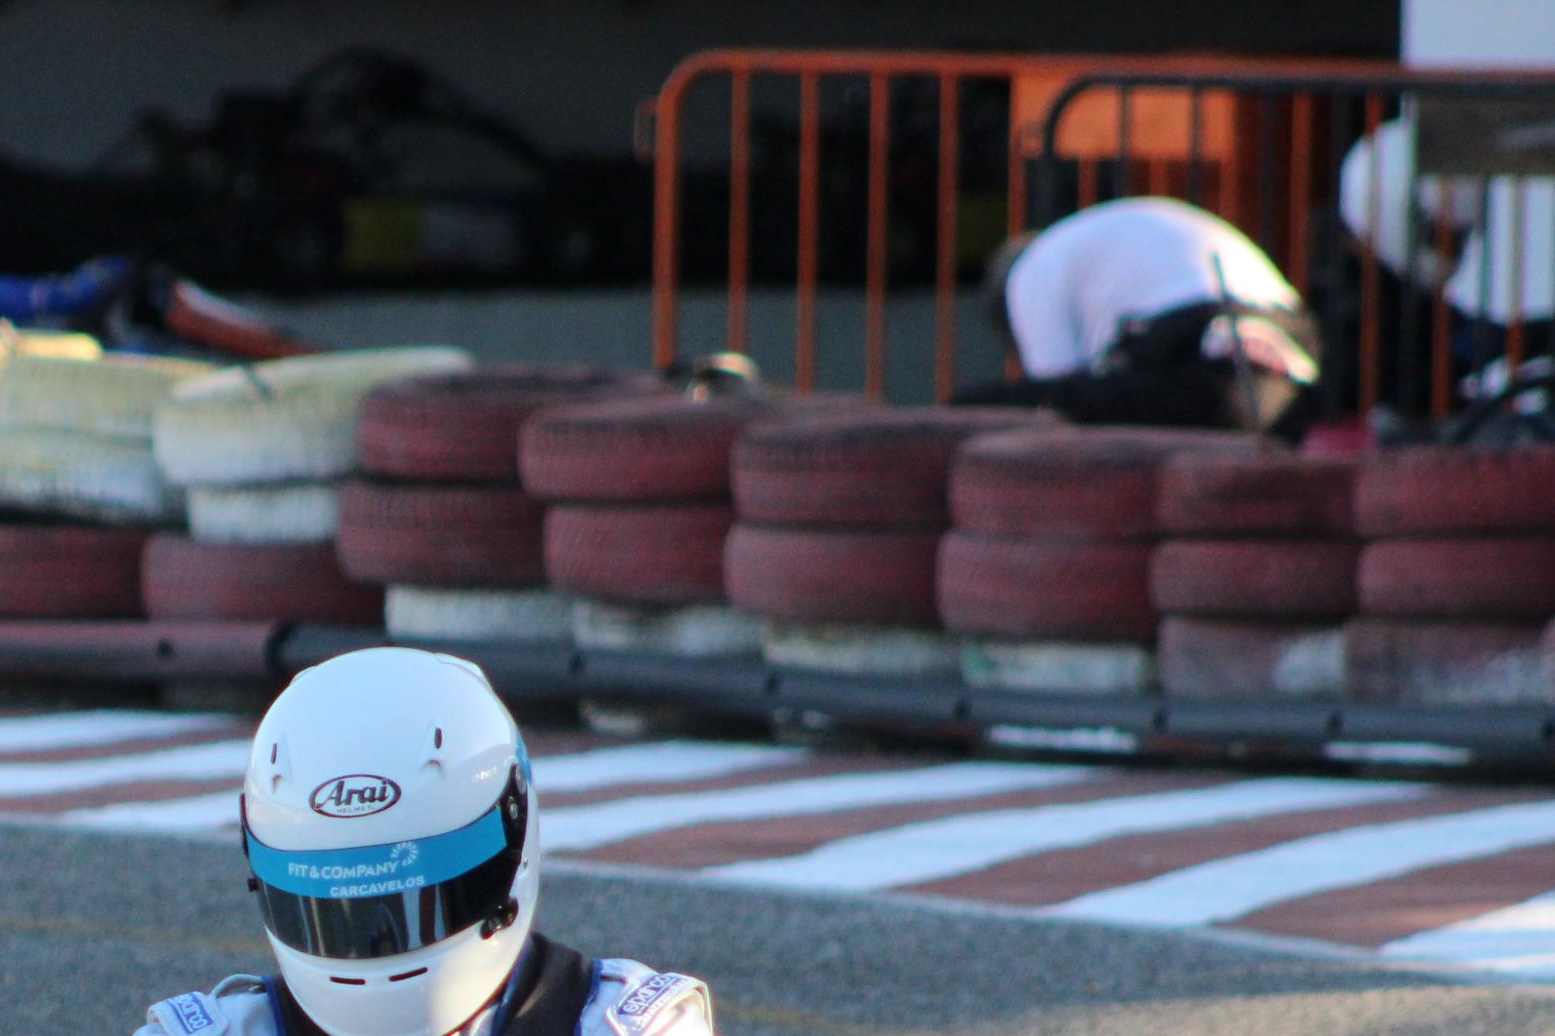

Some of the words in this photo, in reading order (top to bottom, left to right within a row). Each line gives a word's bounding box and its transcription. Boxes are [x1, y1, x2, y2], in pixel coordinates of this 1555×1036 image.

[315, 780, 390, 807] Arai
[288, 861, 398, 880] FIT&COMPANY
[330, 875, 425, 897] CARCAVELOS
[622, 975, 672, 1014] sparco
